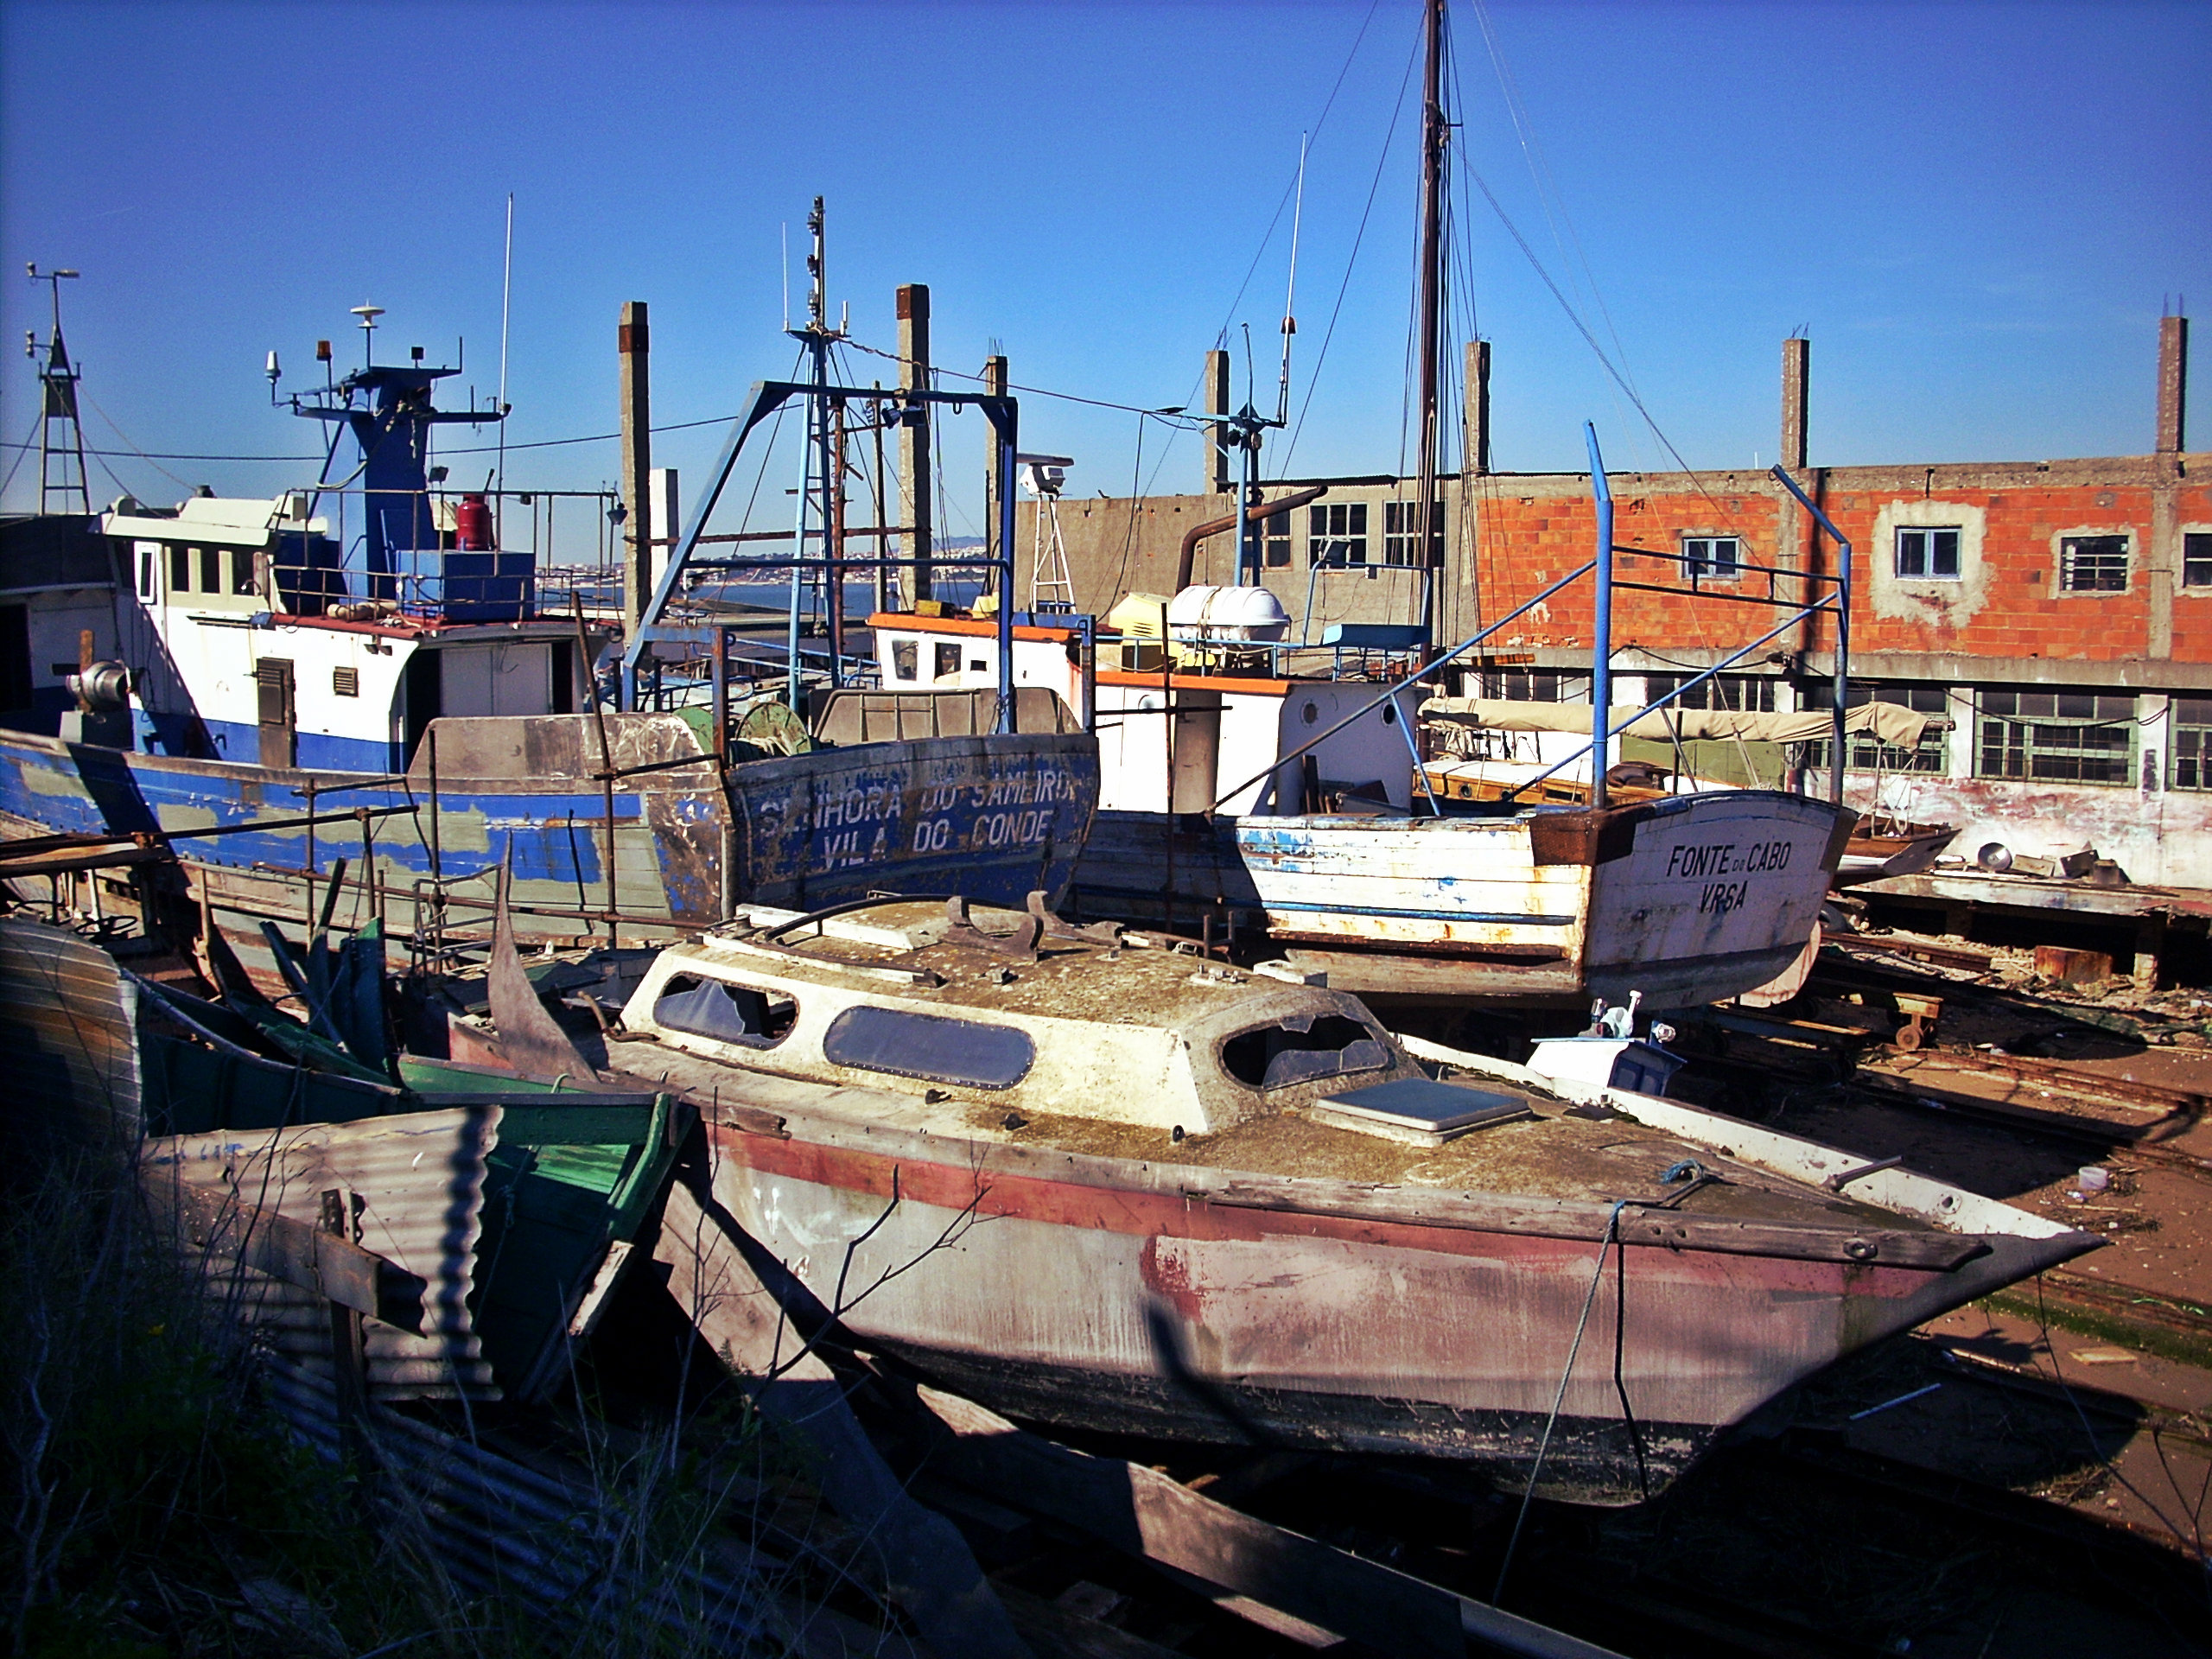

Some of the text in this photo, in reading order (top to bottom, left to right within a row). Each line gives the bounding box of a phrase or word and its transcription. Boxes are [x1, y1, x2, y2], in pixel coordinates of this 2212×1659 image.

[823, 810, 1054, 869] VILA DO CONDE
[1667, 844, 1735, 876] FONTE
[1747, 842, 1791, 872] CABO
